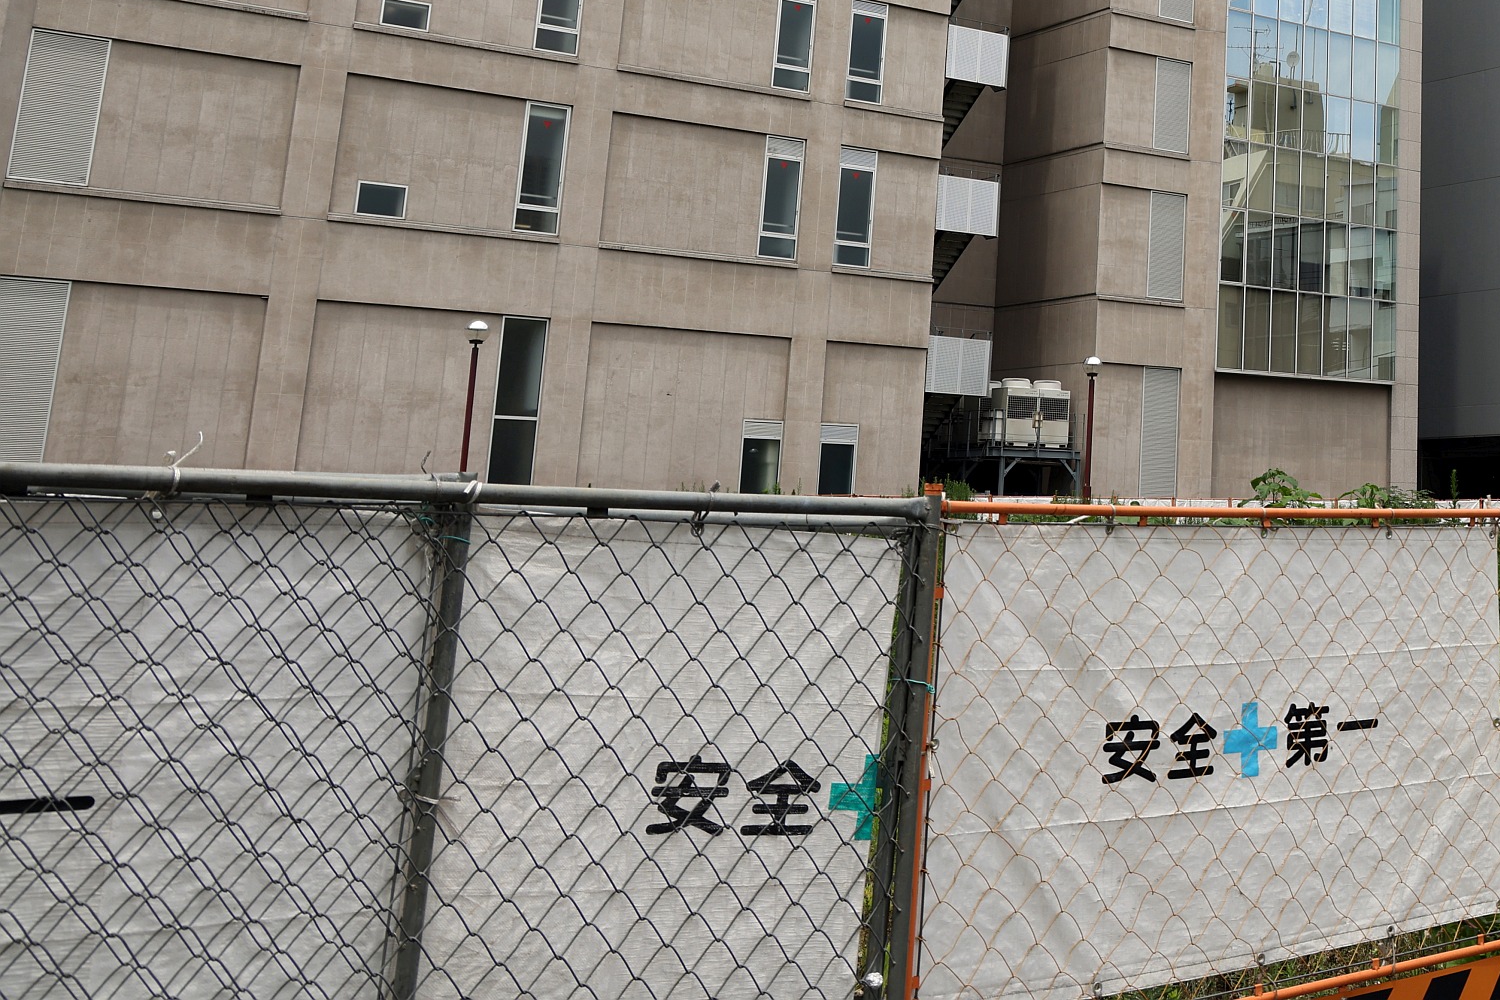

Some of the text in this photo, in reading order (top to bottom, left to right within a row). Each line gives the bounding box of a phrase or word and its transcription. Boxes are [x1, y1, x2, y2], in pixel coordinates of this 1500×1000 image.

[1101, 702, 1379, 783] 安全第一
[646, 756, 822, 837] 安全
